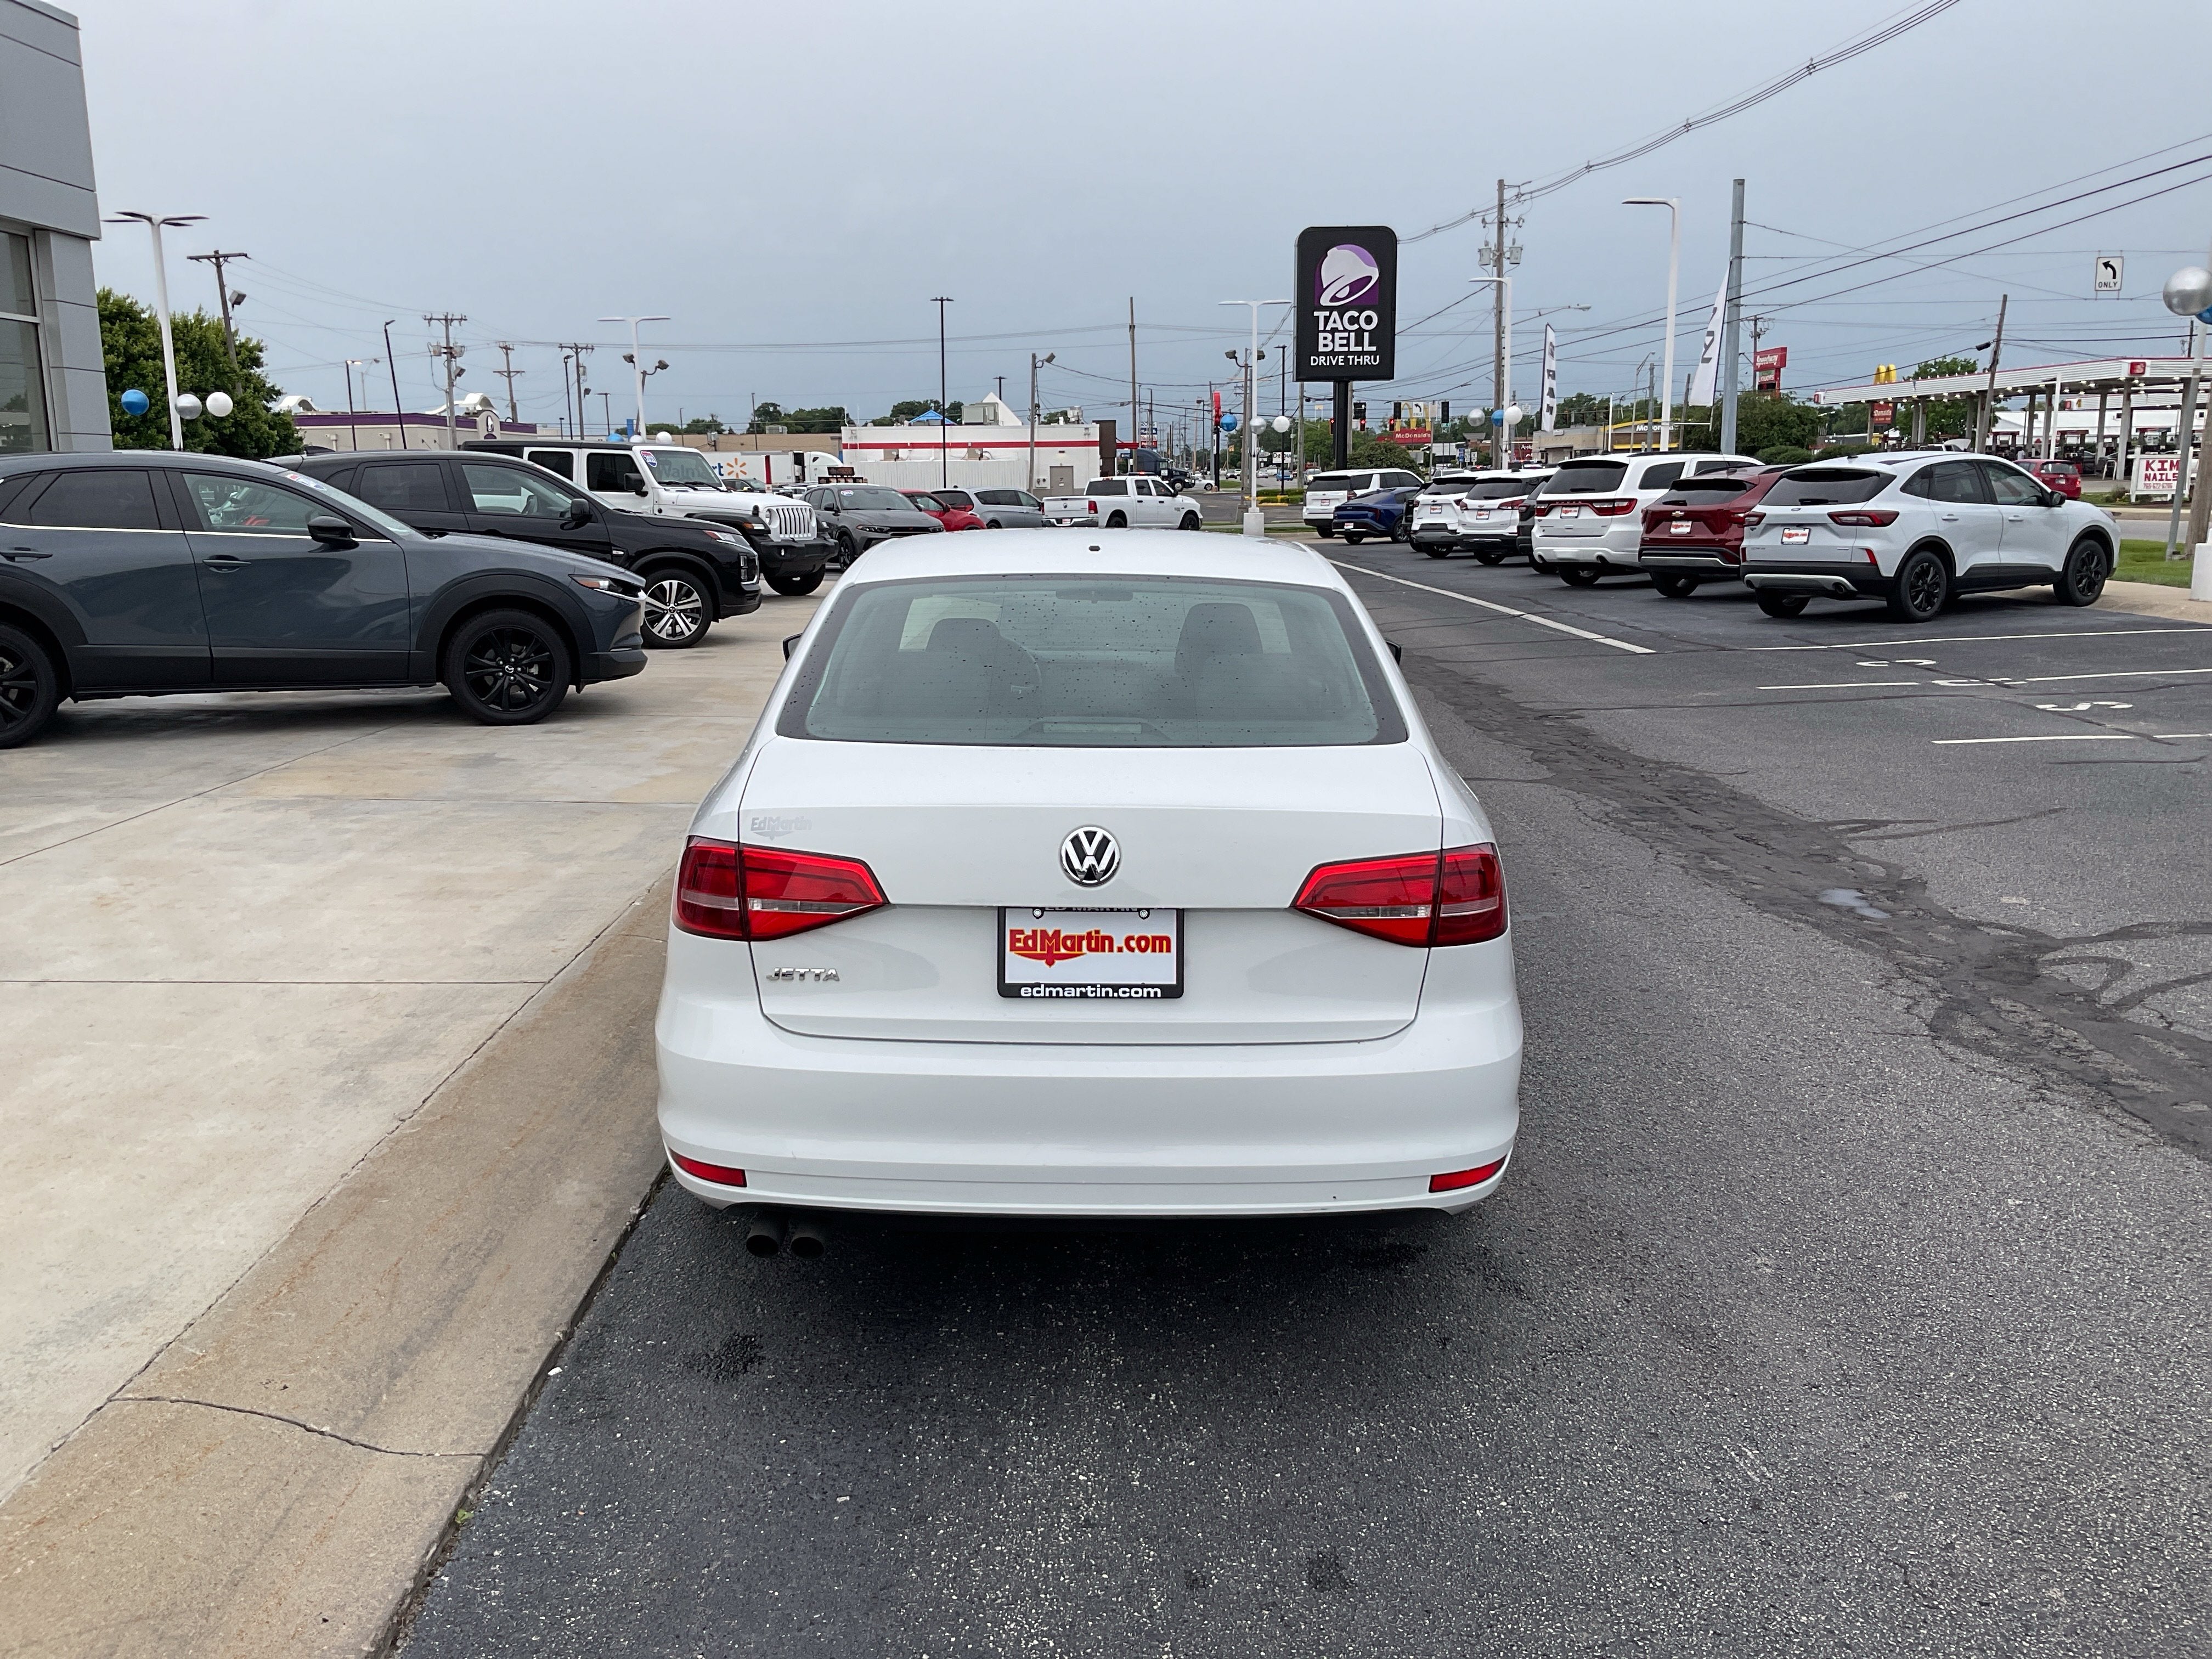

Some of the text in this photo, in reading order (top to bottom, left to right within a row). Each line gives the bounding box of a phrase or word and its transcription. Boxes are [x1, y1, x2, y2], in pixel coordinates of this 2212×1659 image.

[1313, 310, 1378, 331] TACO
[1318, 332, 1377, 352] BELL
[1310, 355, 1380, 366] DRIVE THRU
[2145, 460, 2180, 471] KIM
[2144, 473, 2177, 482] NAILS
[1009, 929, 1172, 956] EdMartin.com
[766, 967, 840, 981] JETTA
[1020, 984, 1161, 997] edmartin.com
